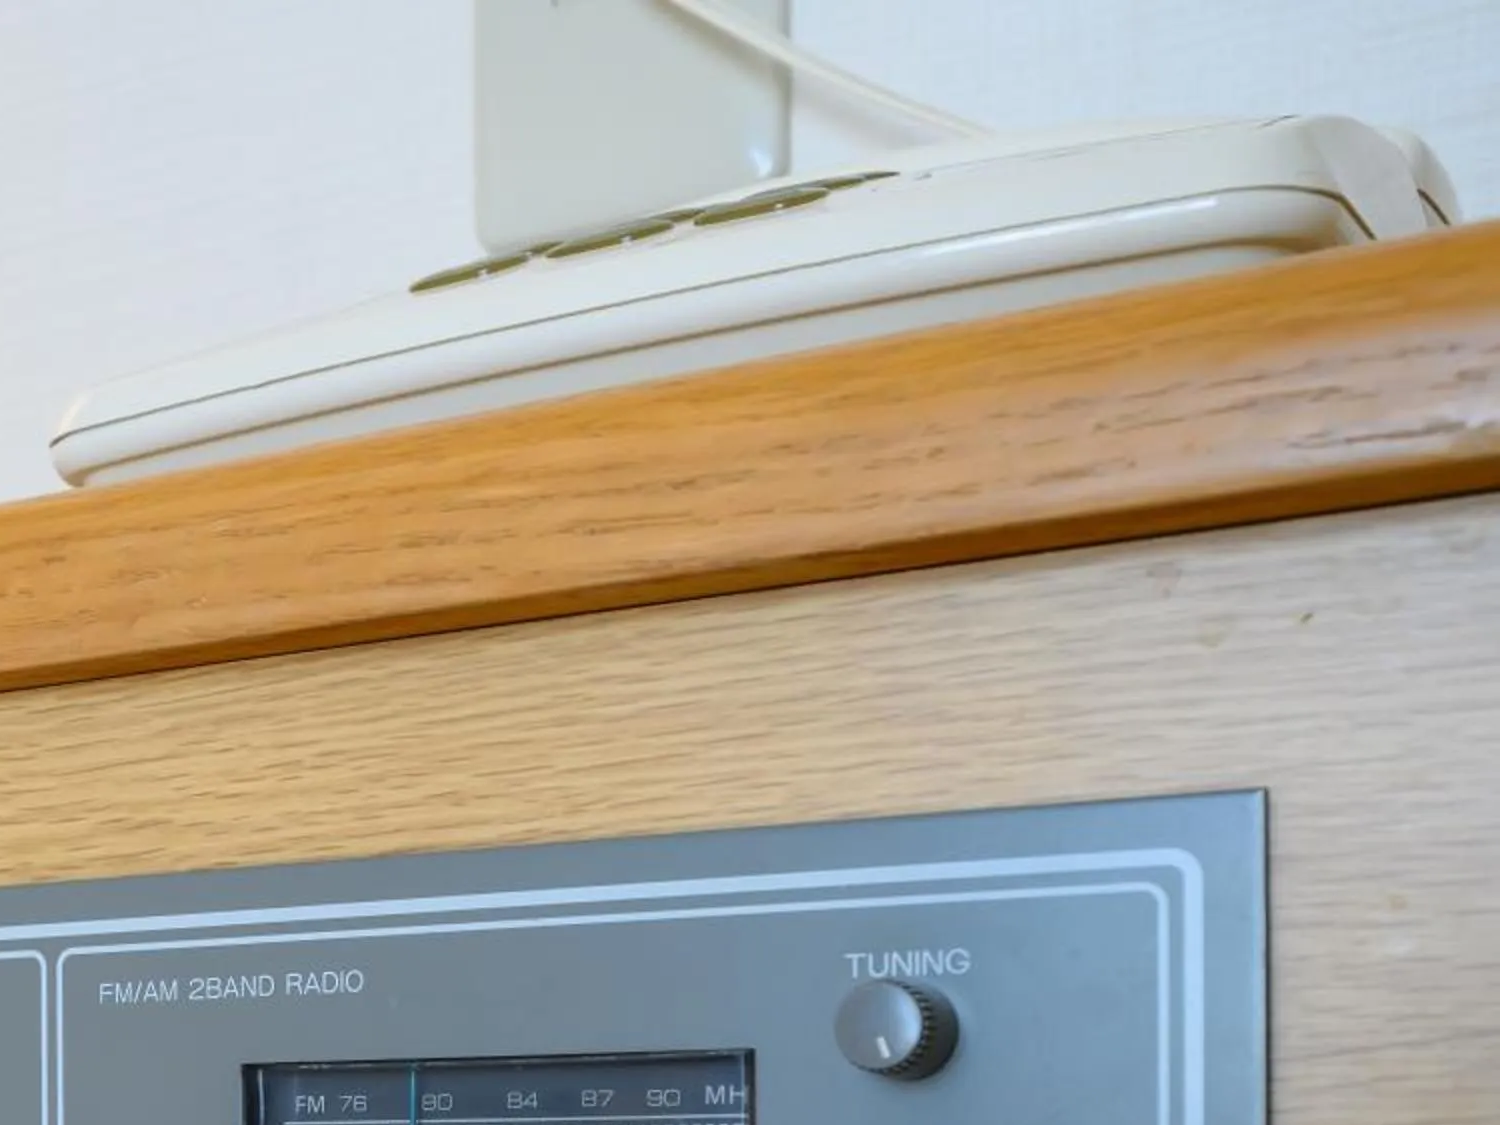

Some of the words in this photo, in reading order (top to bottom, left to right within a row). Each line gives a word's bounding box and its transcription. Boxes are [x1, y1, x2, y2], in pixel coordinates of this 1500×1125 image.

[844, 948, 972, 978] TUNING
[99, 980, 179, 1004] FM/AM
[189, 974, 276, 1001] 2BAND
[285, 968, 365, 996] RADIO
[295, 1095, 325, 1114] FM
[340, 1095, 367, 1113] 76
[507, 1091, 538, 1109] 84
[581, 1089, 615, 1107] 87
[646, 1089, 681, 1107] 90
